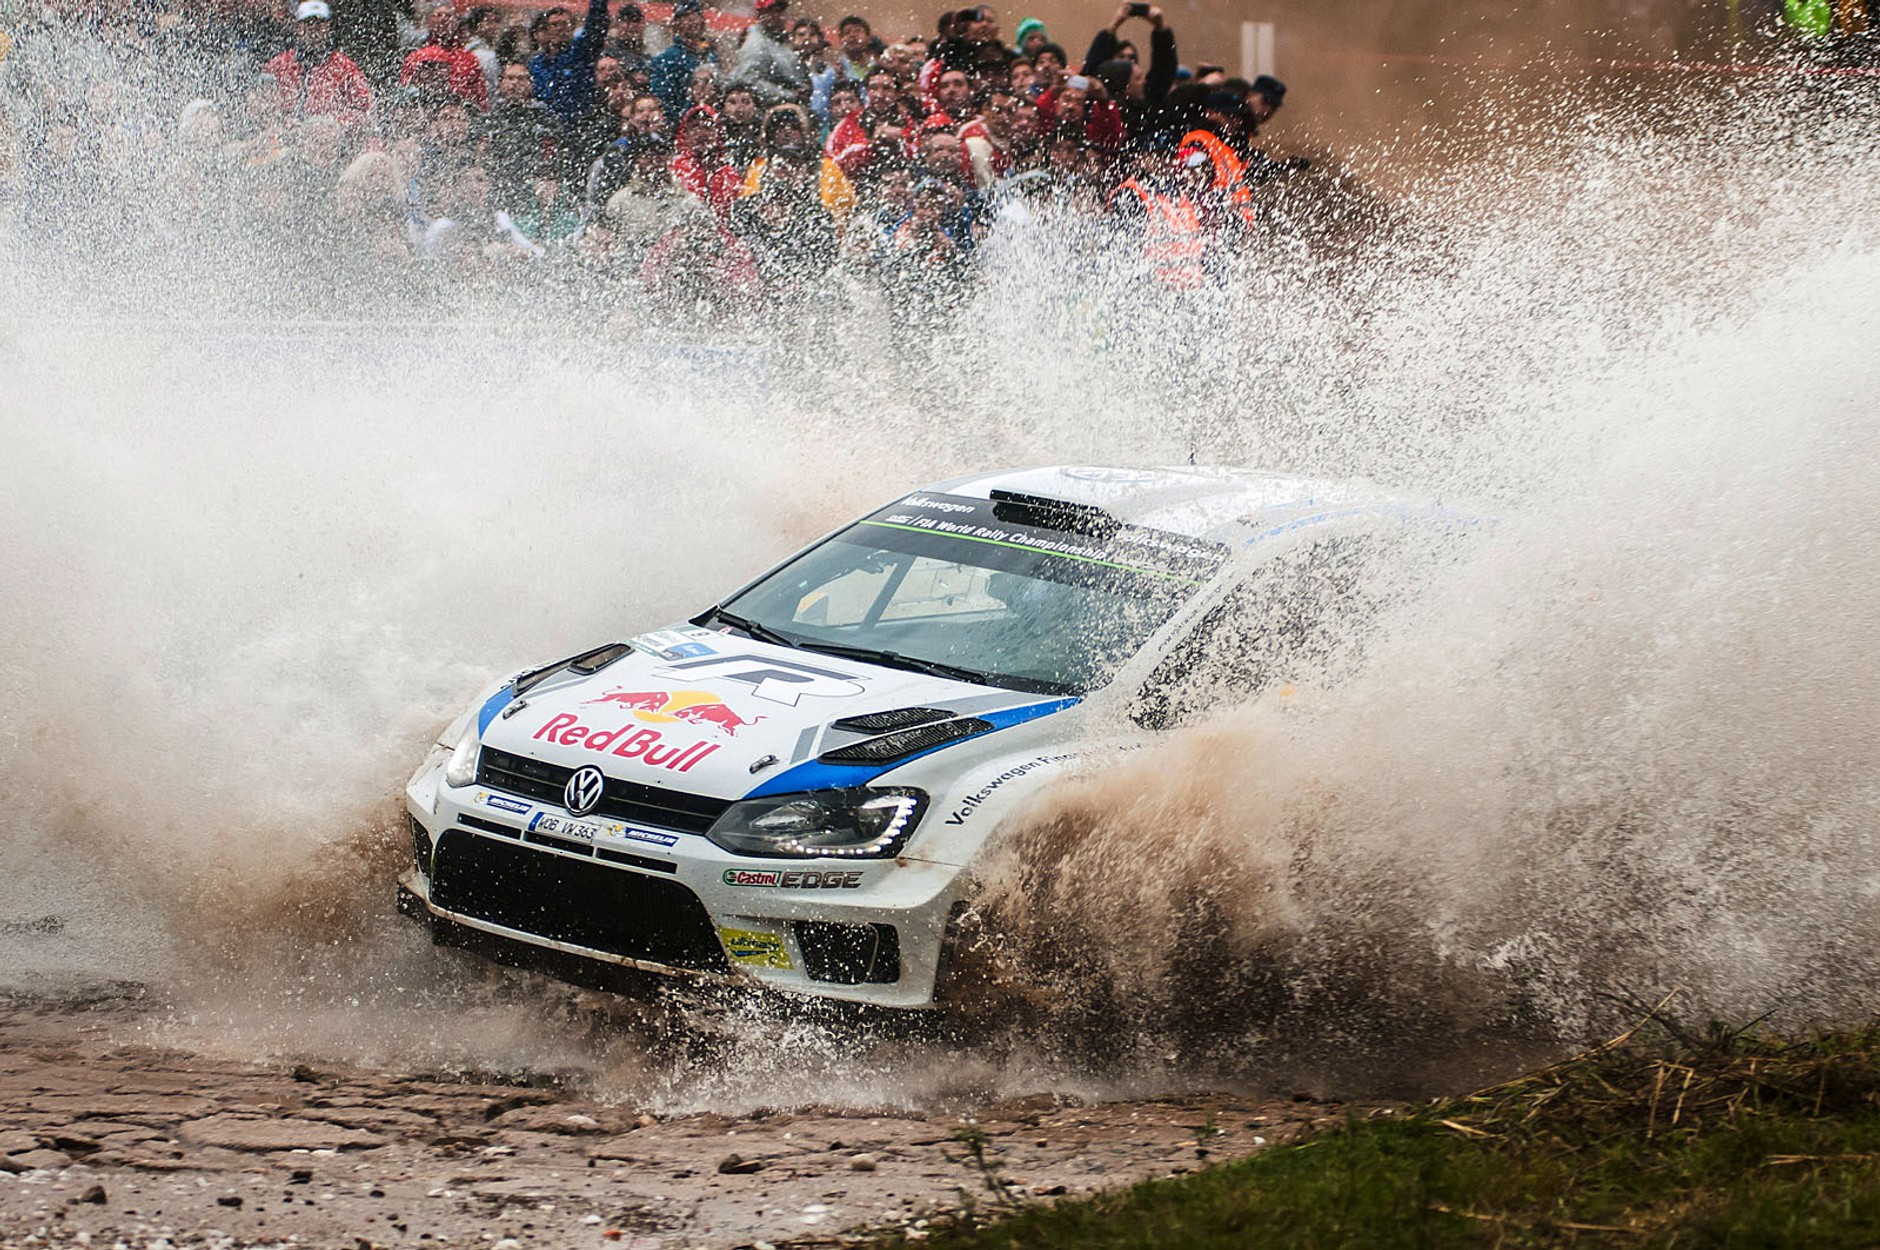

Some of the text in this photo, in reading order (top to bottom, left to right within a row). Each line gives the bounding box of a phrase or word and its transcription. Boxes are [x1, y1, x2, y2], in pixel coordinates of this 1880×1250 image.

[900, 496, 976, 513] Volkswagen
[916, 518, 938, 529] FIA
[935, 521, 975, 534] World
[972, 527, 1009, 541] Rally
[1008, 532, 1108, 560] Championship
[533, 713, 721, 772] Red Bull
[944, 759, 1042, 826] Volkswagen
[489, 797, 531, 812] MICHELIN
[538, 817, 560, 831] WOB
[627, 830, 677, 844] MICHELIN
[737, 871, 864, 889] Castrol EDGE
